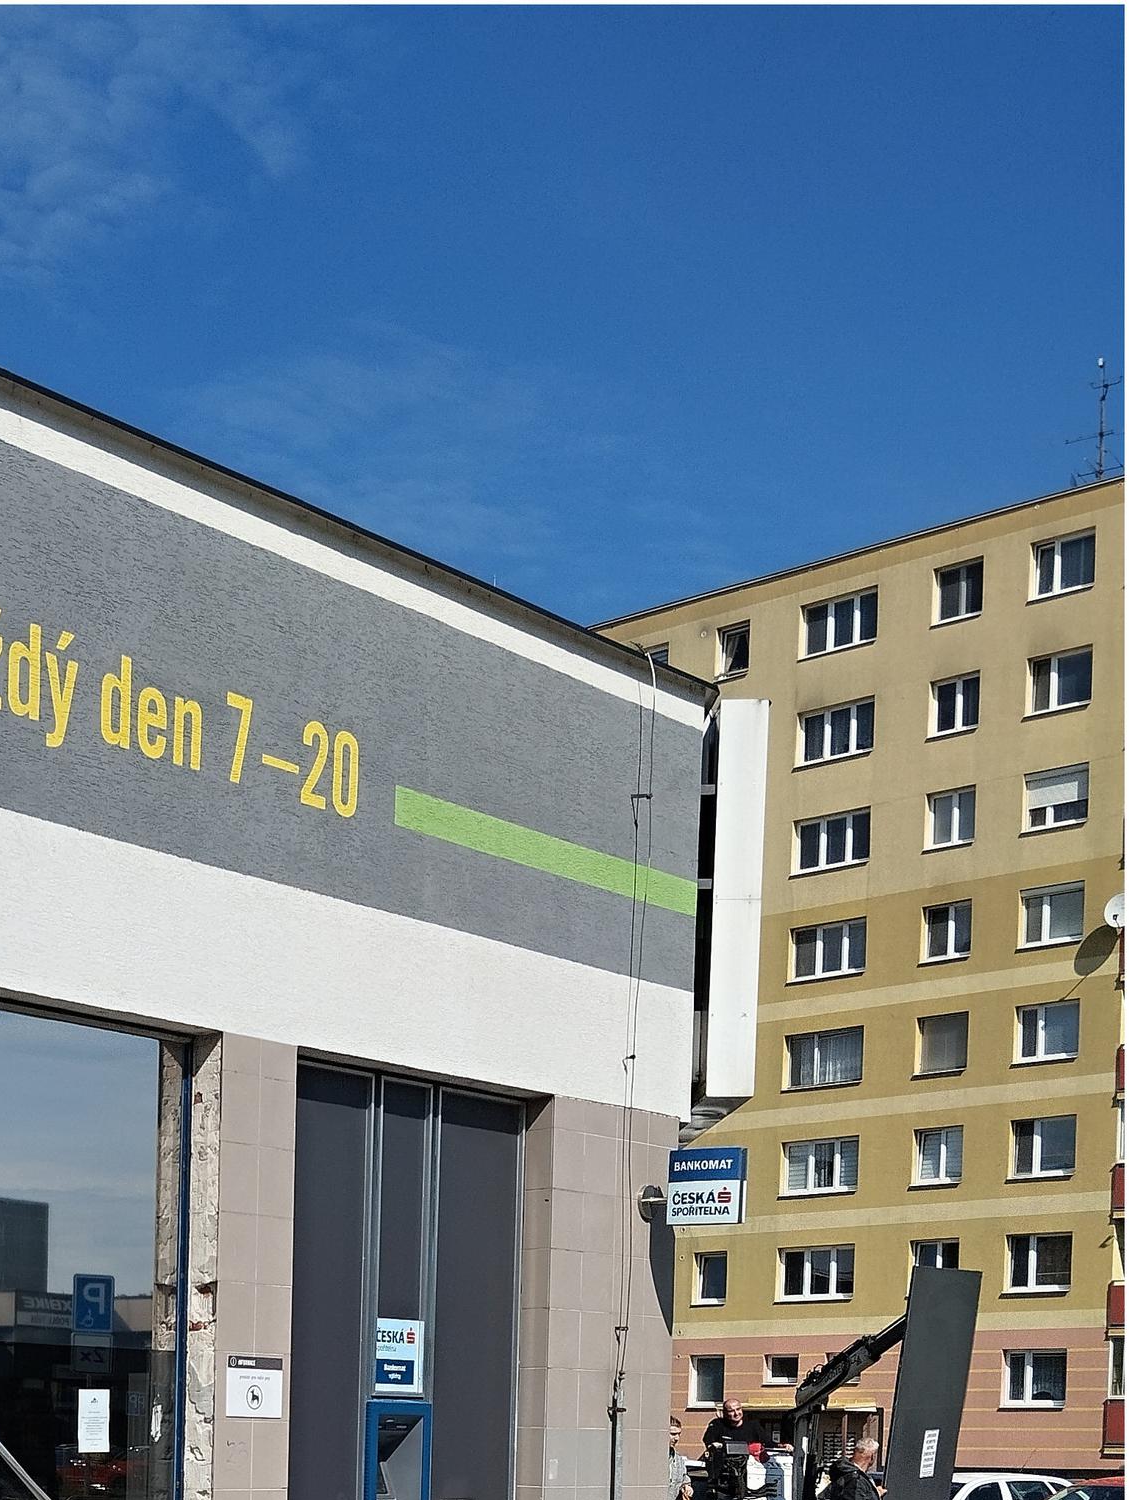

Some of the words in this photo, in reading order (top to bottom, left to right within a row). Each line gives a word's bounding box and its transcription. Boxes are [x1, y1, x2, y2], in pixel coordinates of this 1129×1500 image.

[99, 654, 202, 772] den
[674, 1159, 733, 1172] BANKOMAT
[672, 1189, 716, 1205] ČESKÁ
[672, 1206, 730, 1217] SPOŘITELNA
[376, 1327, 405, 1344] ČESKÁ
